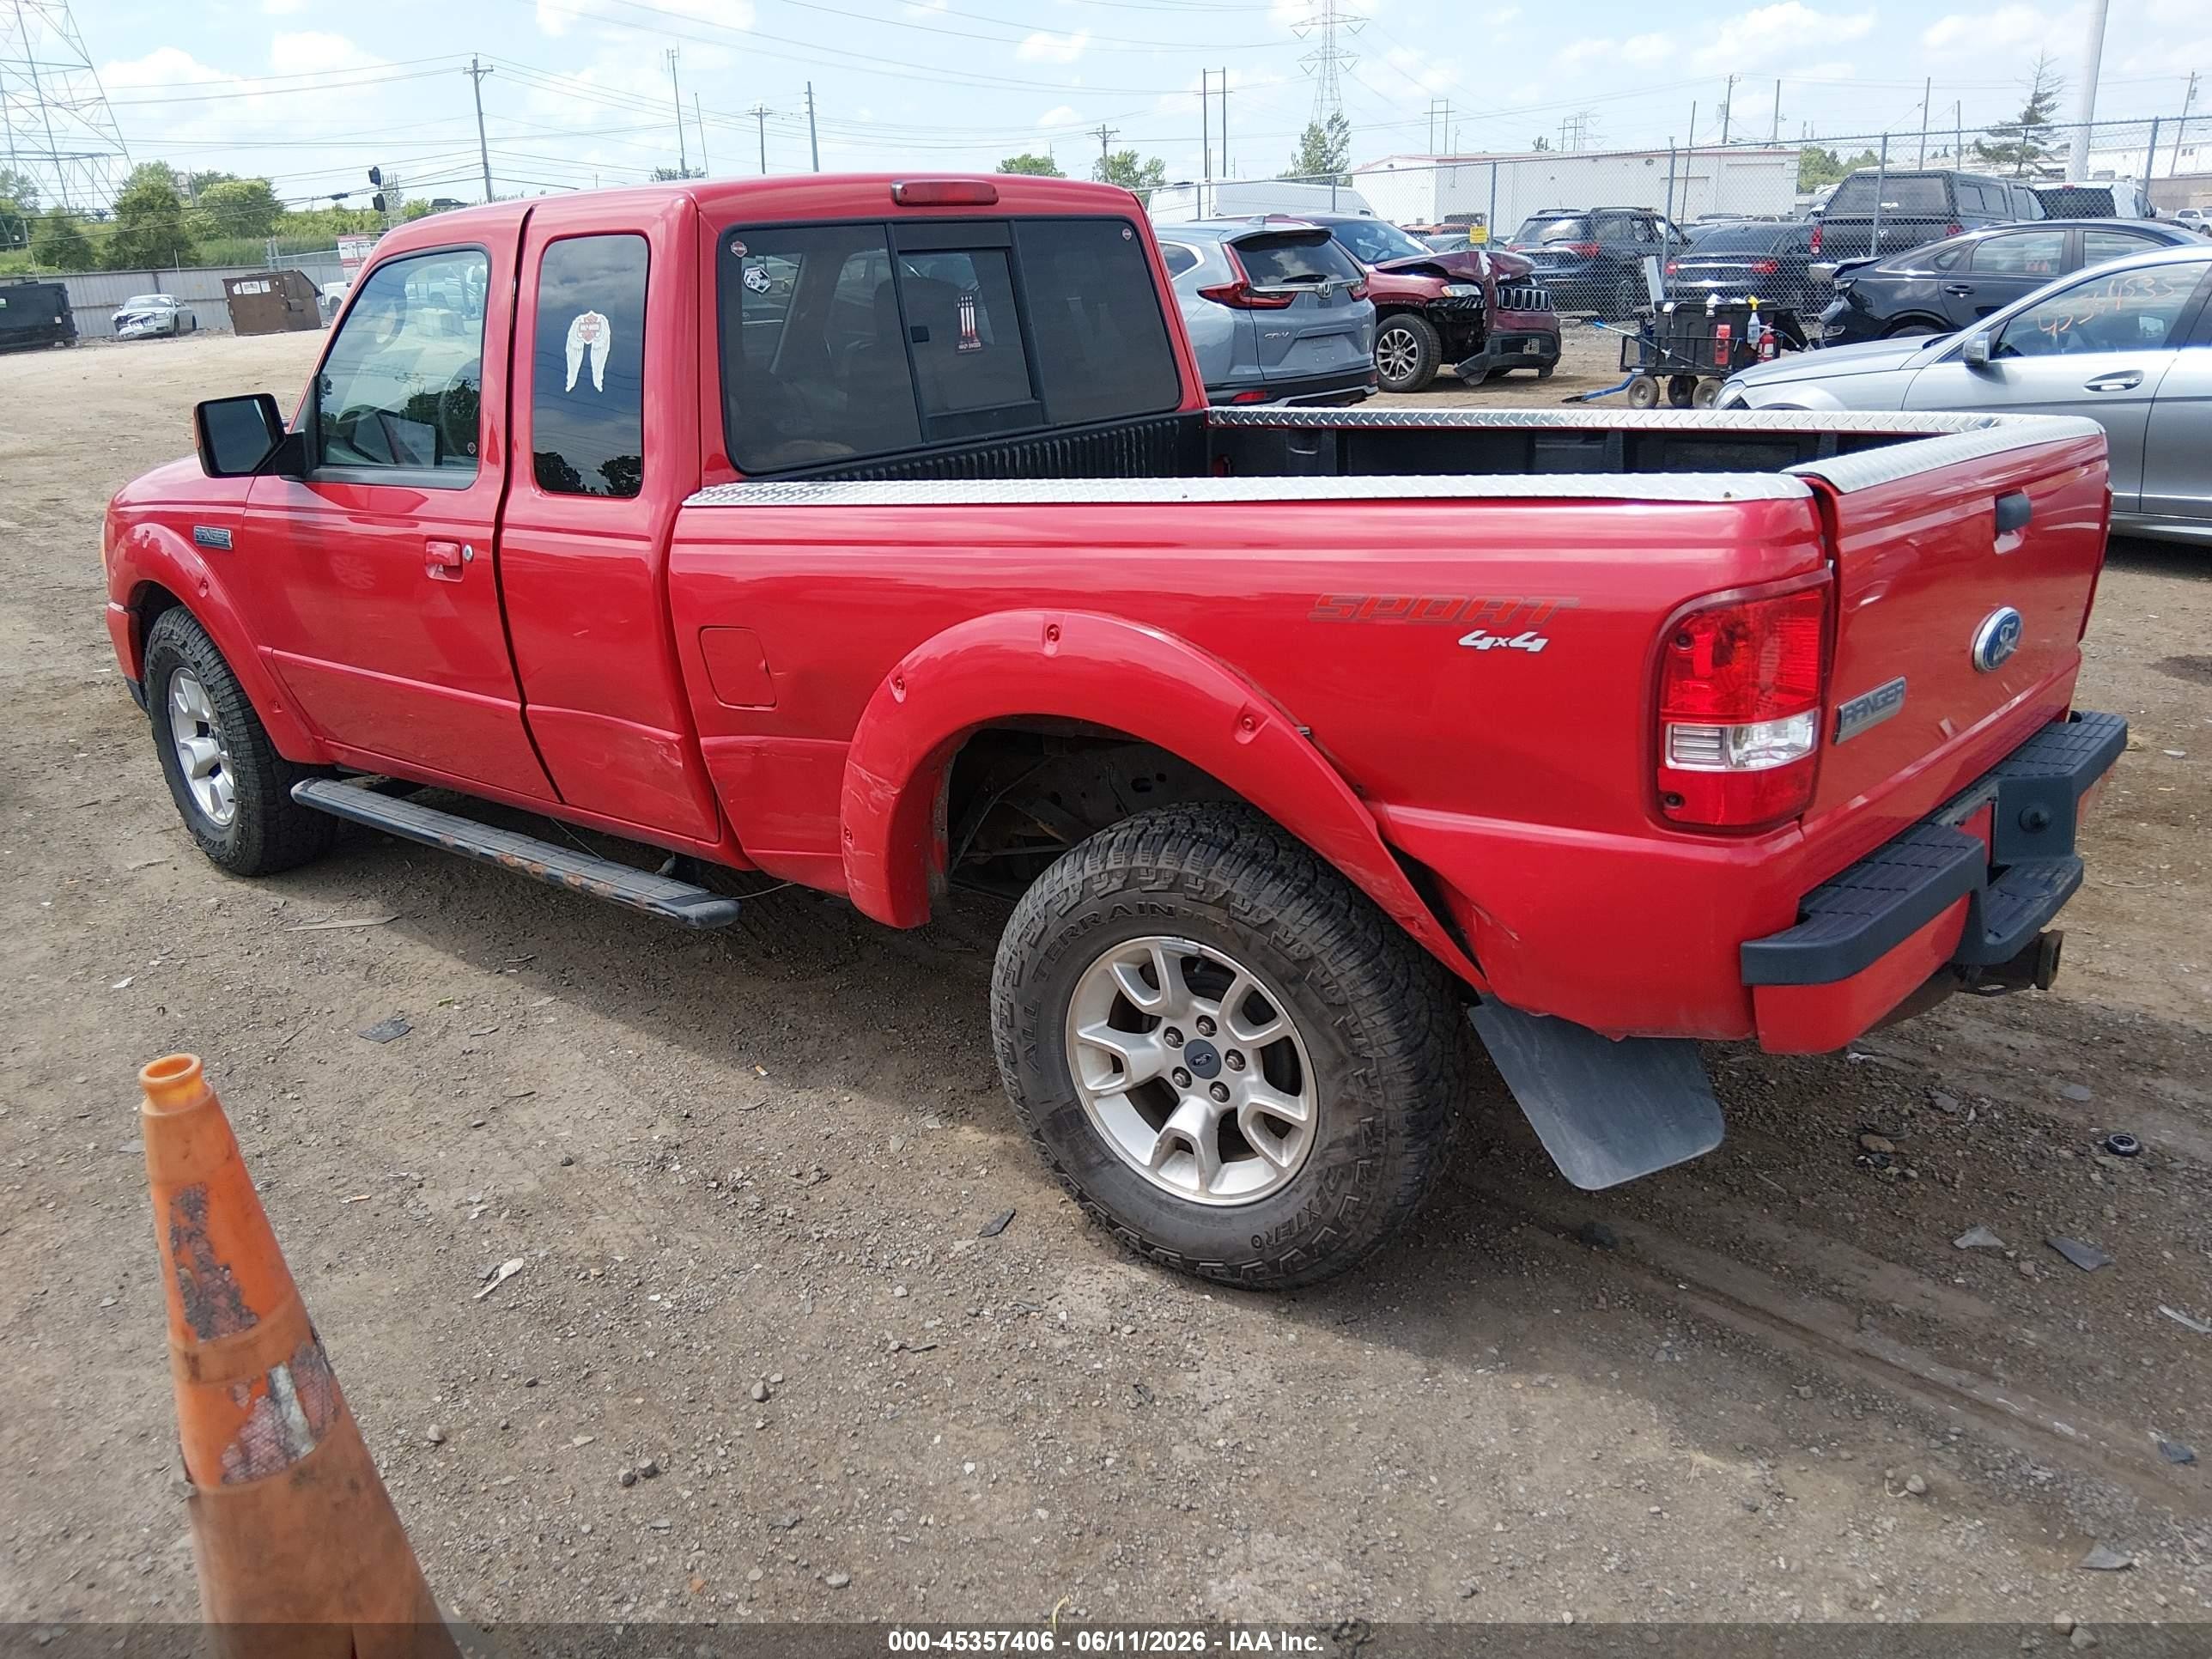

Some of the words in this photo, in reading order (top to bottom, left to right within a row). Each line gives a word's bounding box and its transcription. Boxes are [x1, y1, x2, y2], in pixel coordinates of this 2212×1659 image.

[1308, 592, 1579, 627] SPORT
[1457, 629, 1550, 653] 4x4
[1841, 680, 1905, 728] RANGER
[1031, 901, 1176, 983] TERRAIN
